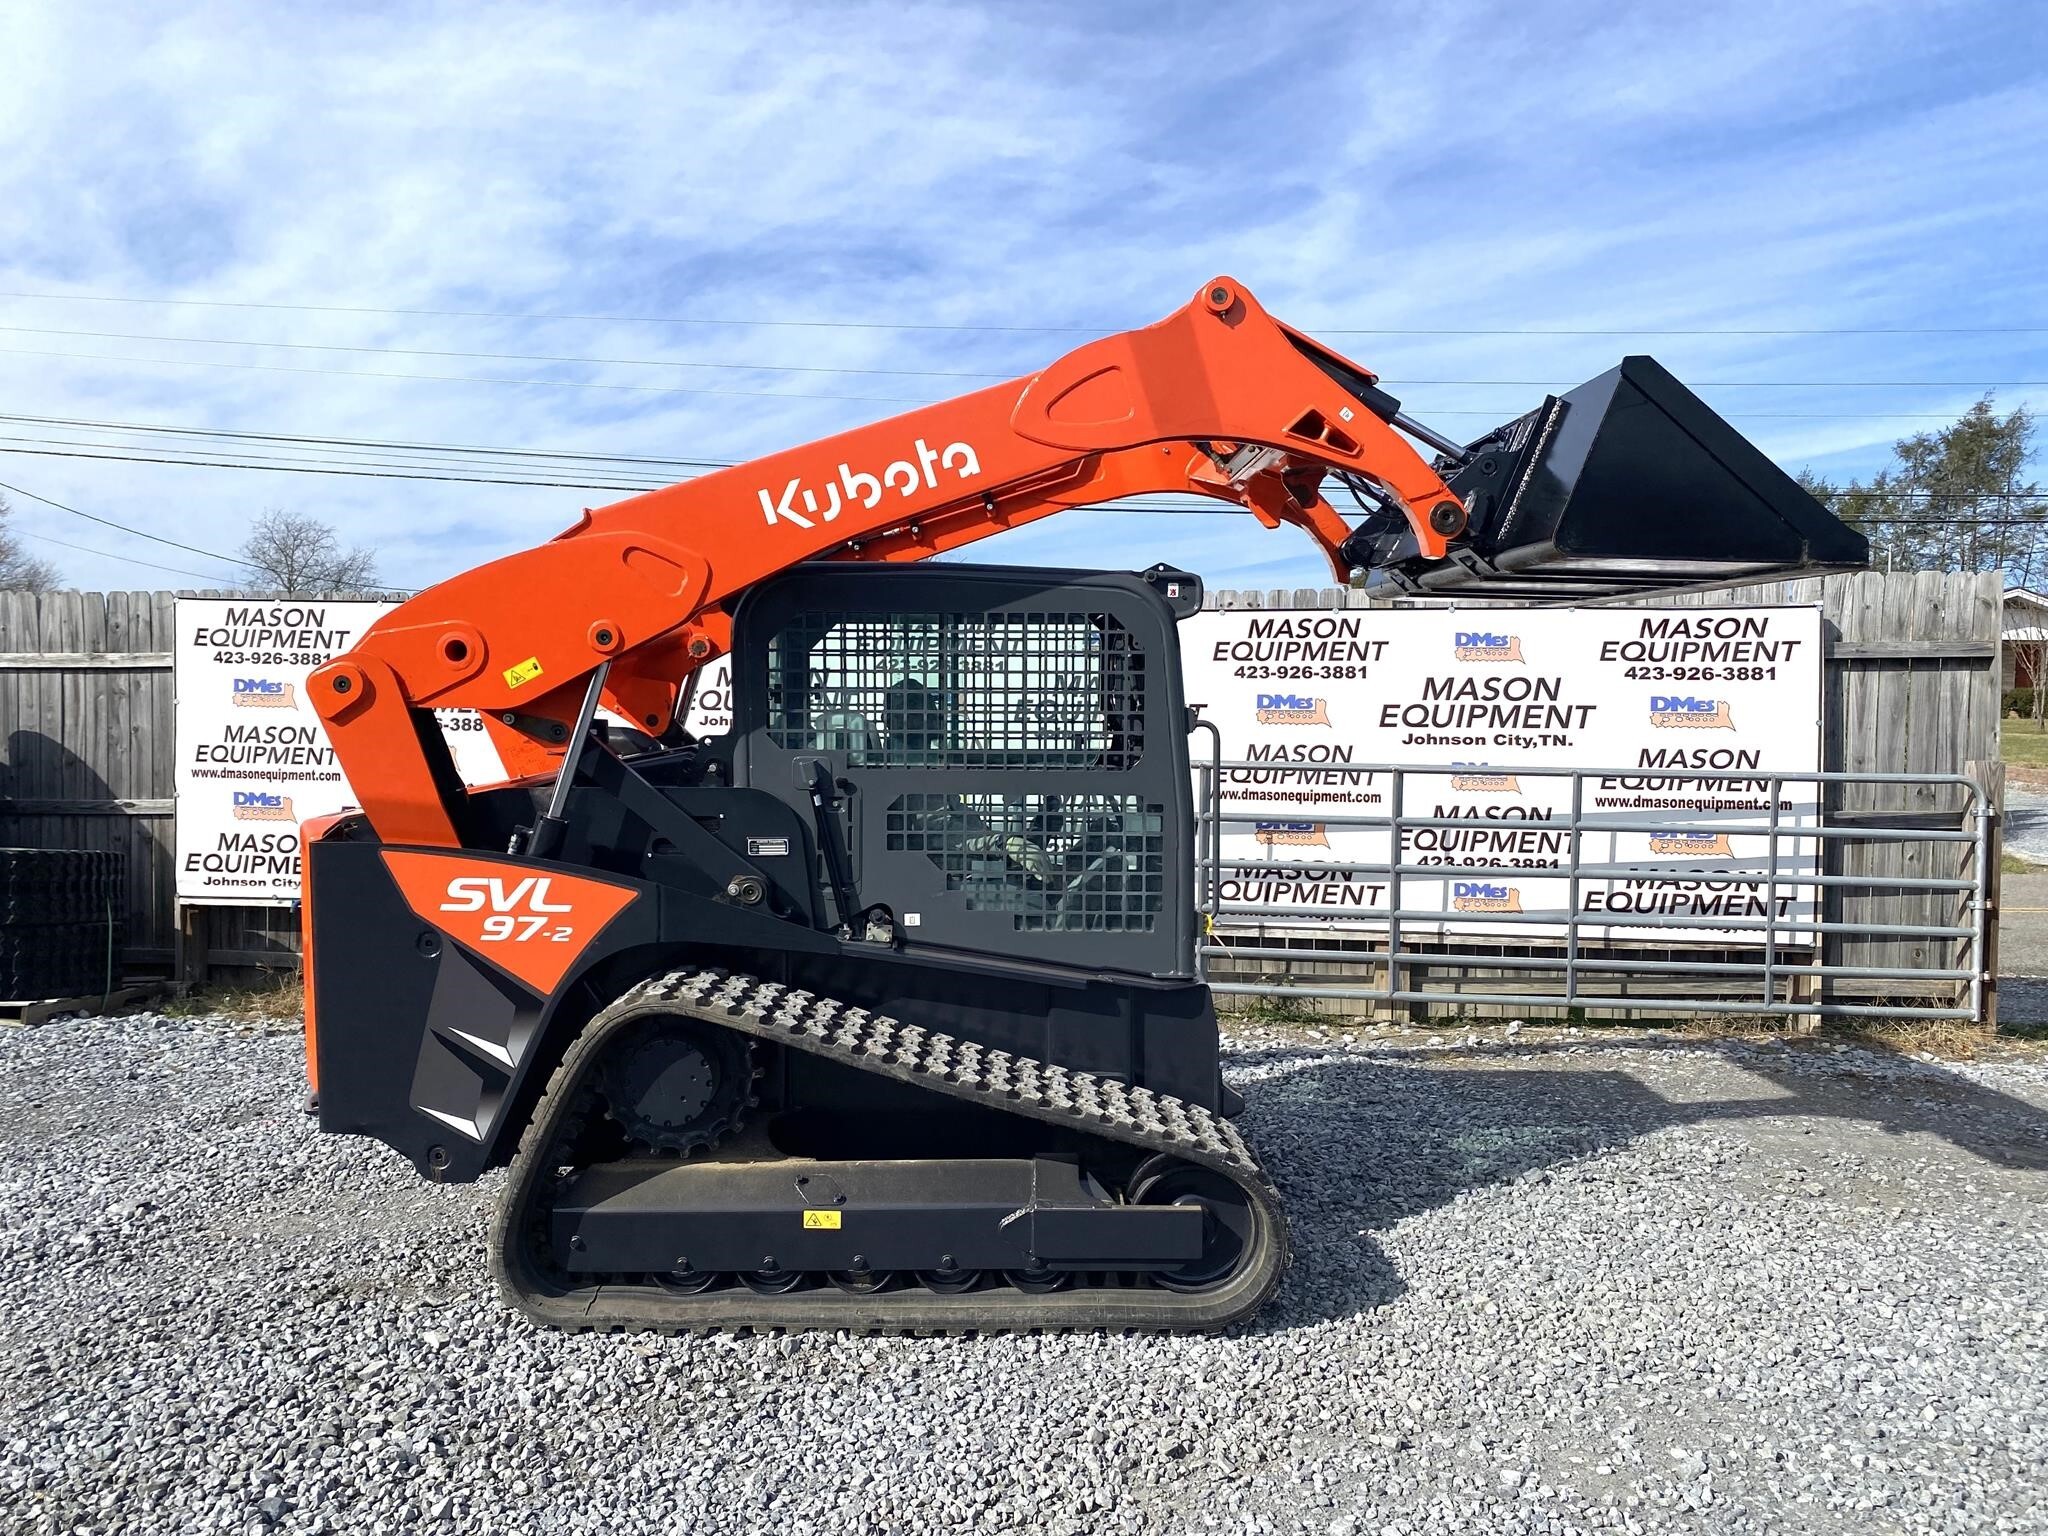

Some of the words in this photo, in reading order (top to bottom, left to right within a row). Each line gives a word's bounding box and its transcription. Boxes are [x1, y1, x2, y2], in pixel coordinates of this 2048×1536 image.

[757, 438, 982, 529] Kubota
[224, 607, 325, 627] MASON
[1248, 617, 1361, 639] MASON
[1639, 617, 1769, 639] MASON
[193, 628, 350, 650] EQUIPMENT
[213, 652, 331, 665] 423-926-3881
[1212, 641, 1389, 661] EQUIPMENT
[1599, 640, 1801, 663] EQUIPMENT
[1234, 666, 1367, 680] 423-926-3881
[1624, 666, 1777, 681] 423-926-3881
[1422, 676, 1562, 701] MASON
[1379, 704, 1597, 730] EQUIPMENT
[223, 725, 317, 744] MASON
[1402, 733, 1487, 746] Johnson
[1493, 734, 1574, 749] City,TN.
[194, 745, 336, 766] EQUIPMENT
[1246, 744, 1353, 763] MASON
[1637, 749, 1761, 770] MASON
[191, 768, 341, 783] www.dmasonequipment.com
[1600, 775, 1784, 793] EQUIPMEN
[1210, 788, 1382, 805] ww.dmasonequipment.com
[1595, 795, 1793, 812] www.dmasonequipment.cm
[1433, 805, 1553, 821] MASON
[217, 833, 301, 854] MASO
[184, 854, 301, 875] EQUIPME
[1417, 855, 1560, 869] 423-926-3881
[203, 876, 267, 888] Johnson
[272, 876, 301, 890] City
[439, 877, 573, 912] SVL
[1583, 891, 1797, 917] EQUIPMENT
[479, 915, 574, 942] 97-2
